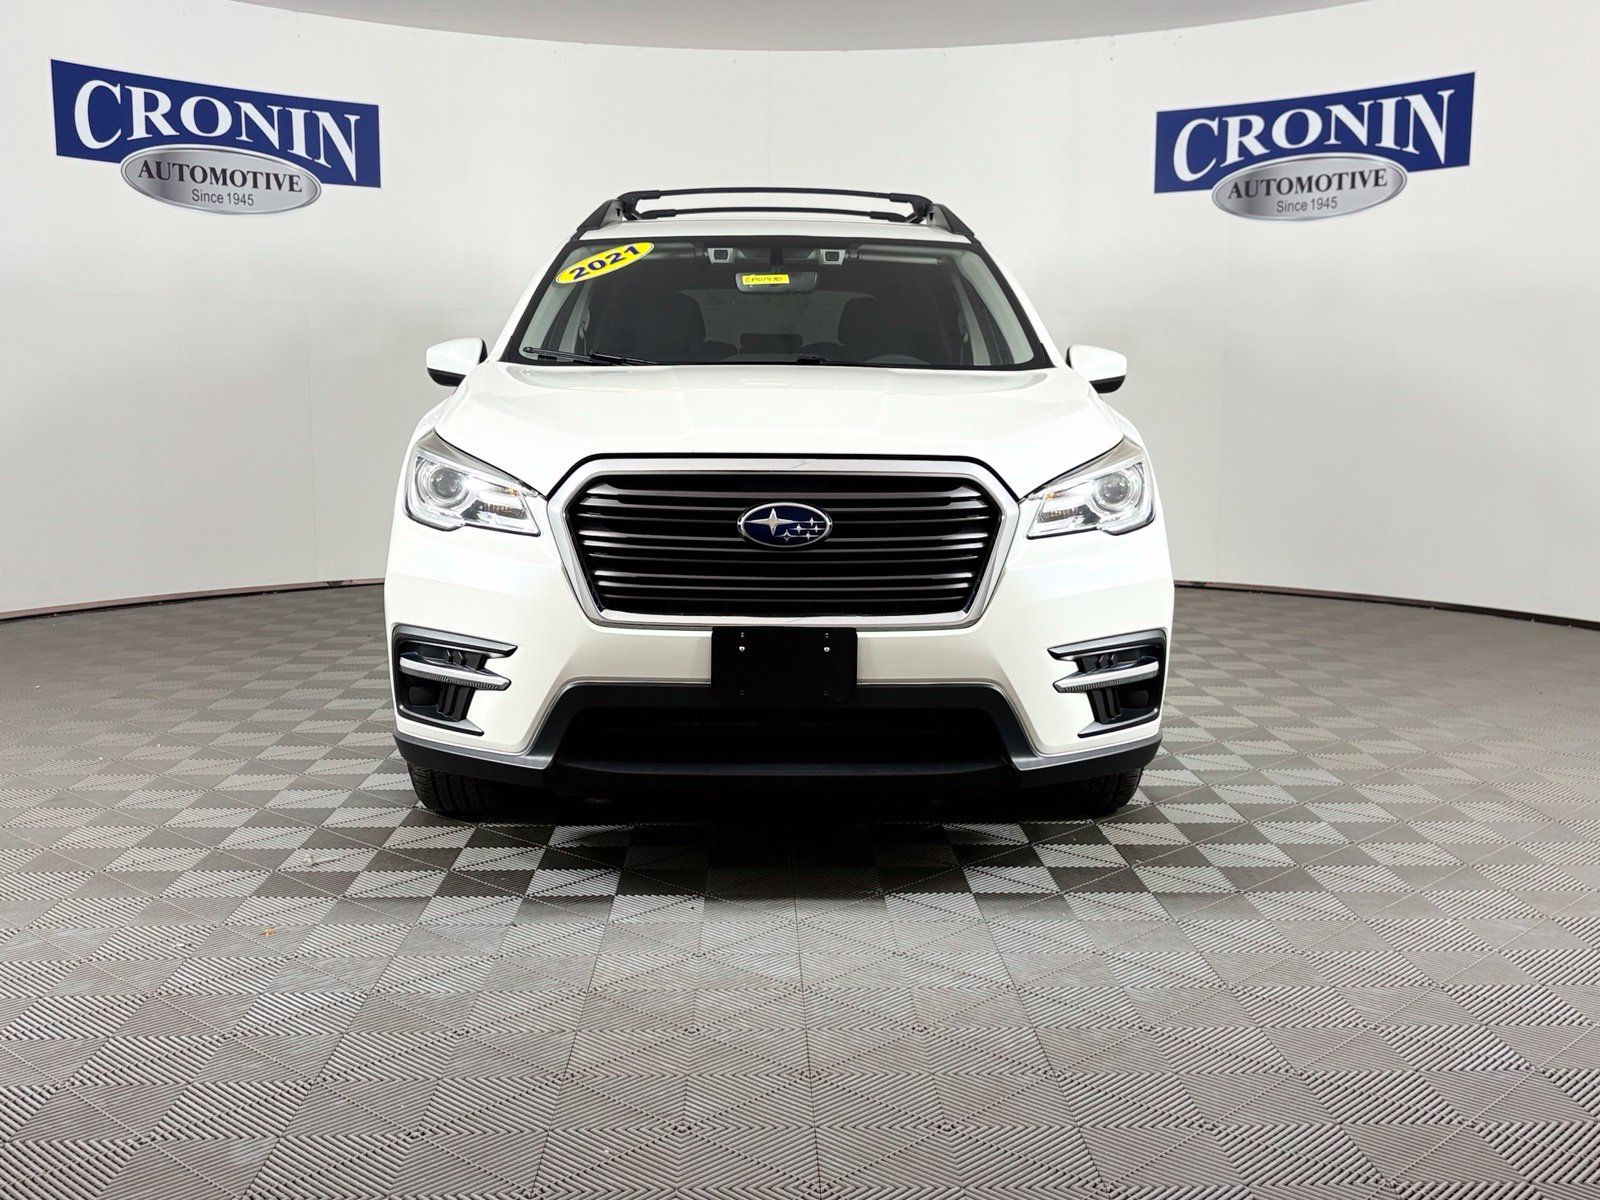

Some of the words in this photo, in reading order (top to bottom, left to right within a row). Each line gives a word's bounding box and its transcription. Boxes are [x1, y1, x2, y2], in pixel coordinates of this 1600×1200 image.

[74, 79, 361, 182] CRONIN
[1173, 89, 1455, 182] CRONIN
[138, 159, 303, 193] AUTOMOTIVE
[1227, 168, 1388, 200] AUTOMOTIVE
[191, 188, 224, 204] Since
[227, 193, 255, 207] 1945
[1276, 200, 1308, 214] Since
[1311, 196, 1338, 210] 1945
[569, 245, 640, 280] 2021
